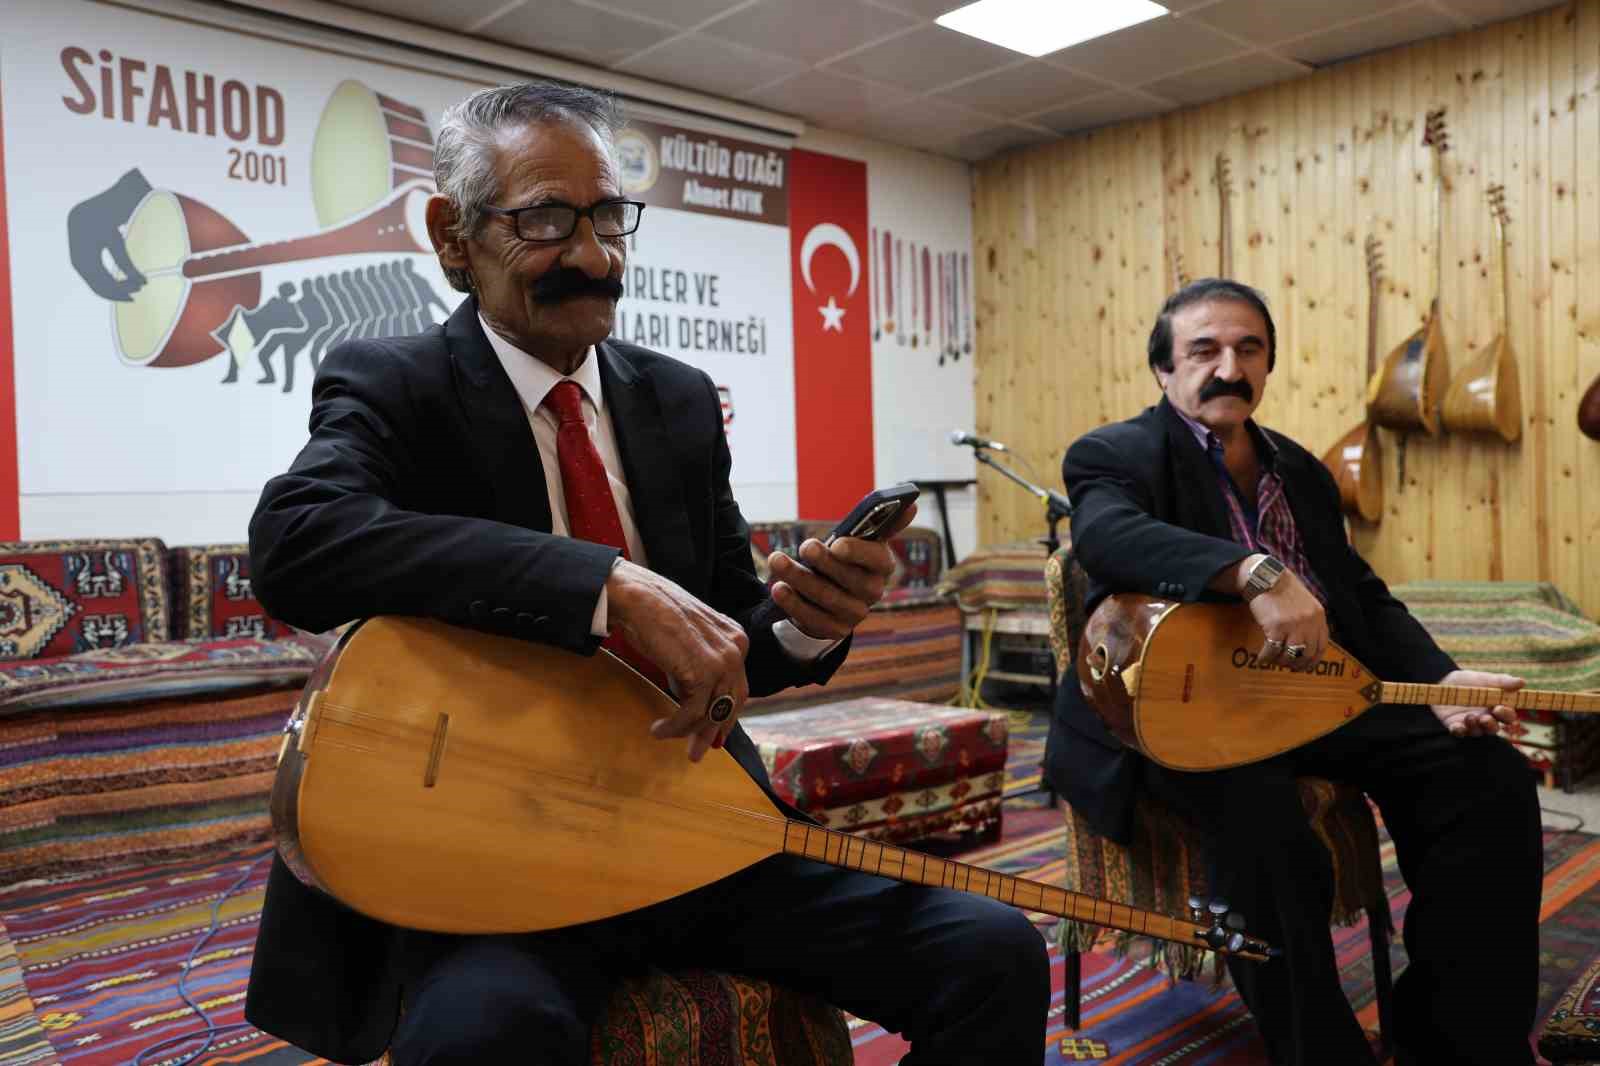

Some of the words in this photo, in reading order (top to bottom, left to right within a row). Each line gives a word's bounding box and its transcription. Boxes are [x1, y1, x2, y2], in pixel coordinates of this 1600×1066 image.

[228, 148, 287, 186] 2001
[660, 133, 730, 178] KÜLTÜR
[733, 151, 784, 188] OTAĞI
[694, 272, 720, 307] VE
[621, 311, 670, 348] LARI
[1231, 647, 1282, 672] Oz
